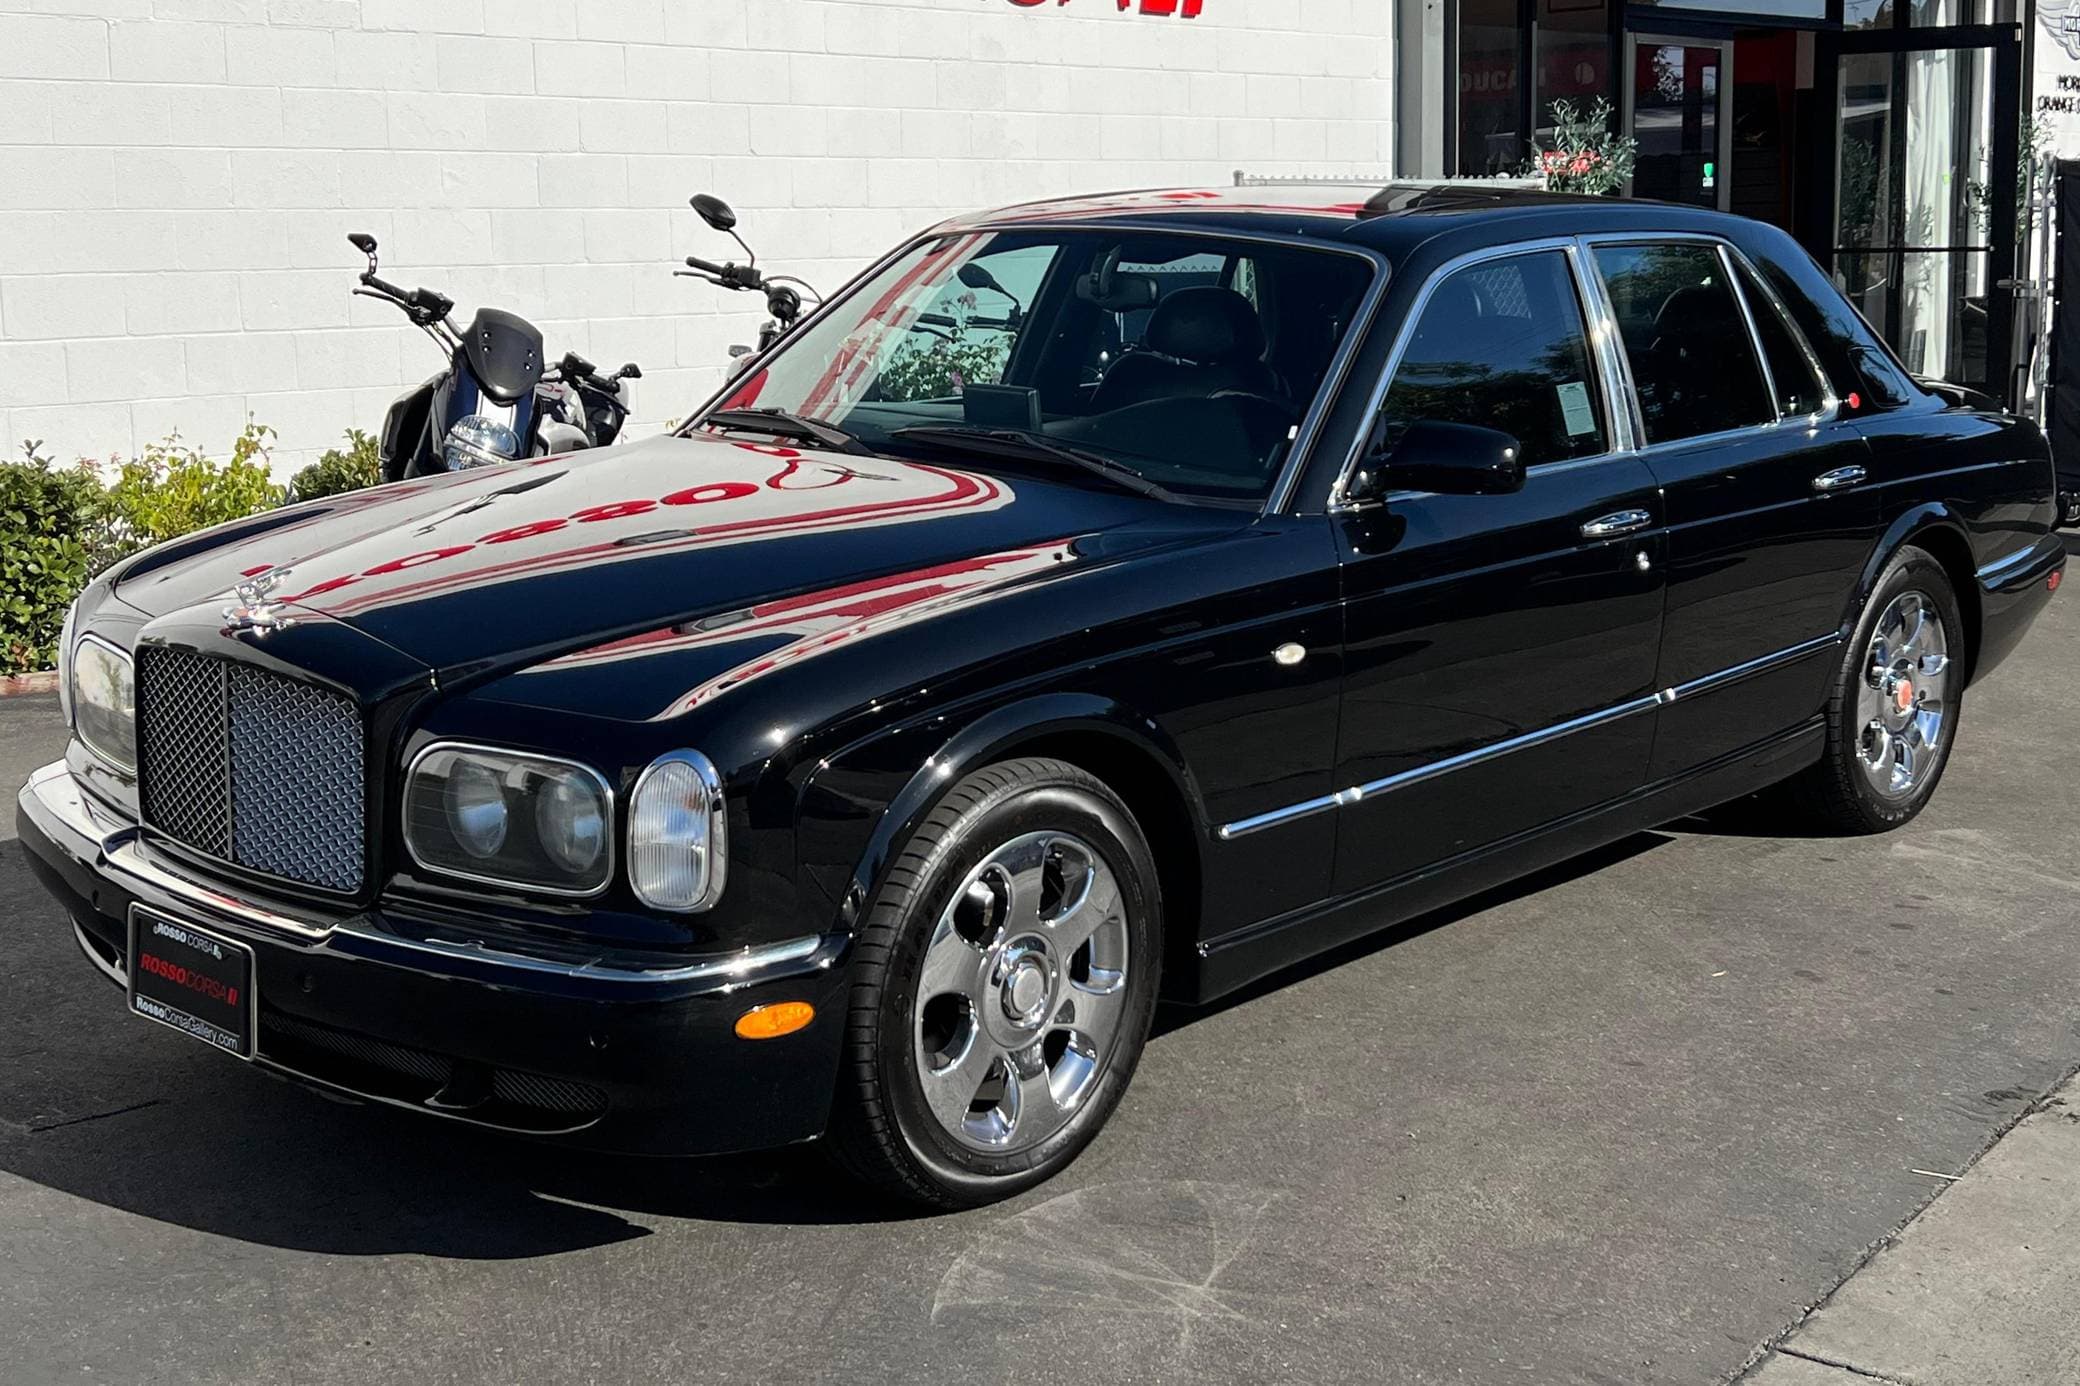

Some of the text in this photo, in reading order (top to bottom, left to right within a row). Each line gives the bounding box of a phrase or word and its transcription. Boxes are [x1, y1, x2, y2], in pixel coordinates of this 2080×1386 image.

[2037, 96, 2075, 113] ORANGE
[158, 922, 213, 954] ROSSO CORSA
[136, 996, 238, 1050] RossoCorsaGallery.com
